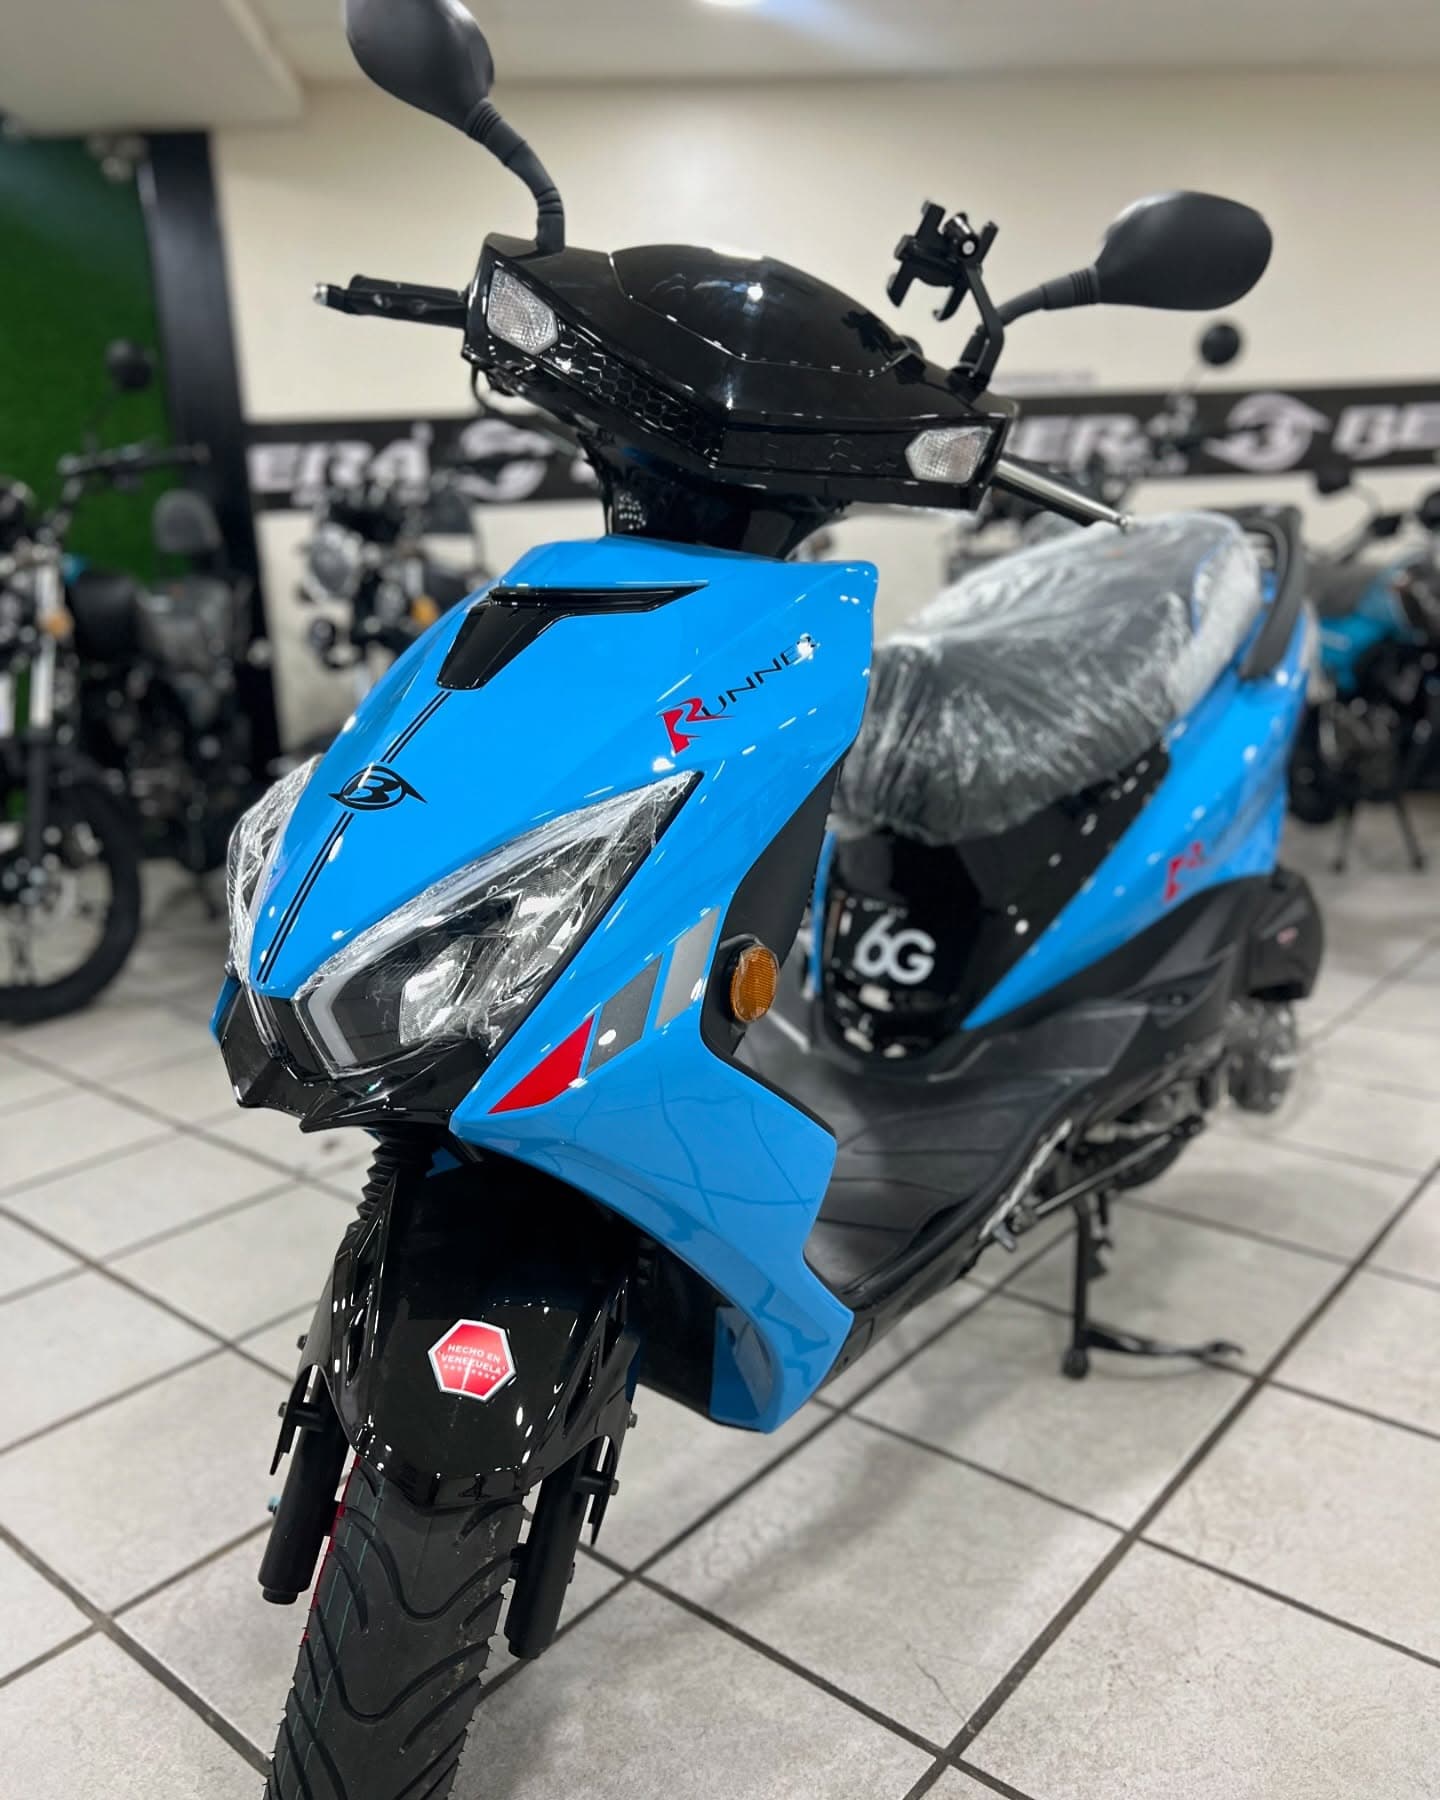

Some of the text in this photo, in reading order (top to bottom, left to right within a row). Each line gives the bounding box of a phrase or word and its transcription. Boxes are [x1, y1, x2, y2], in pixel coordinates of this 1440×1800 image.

[248, 439, 430, 504] ERA
[659, 635, 815, 754] RUNNE
[853, 914, 936, 985] 6G
[448, 1344, 500, 1364] HECHO EN
